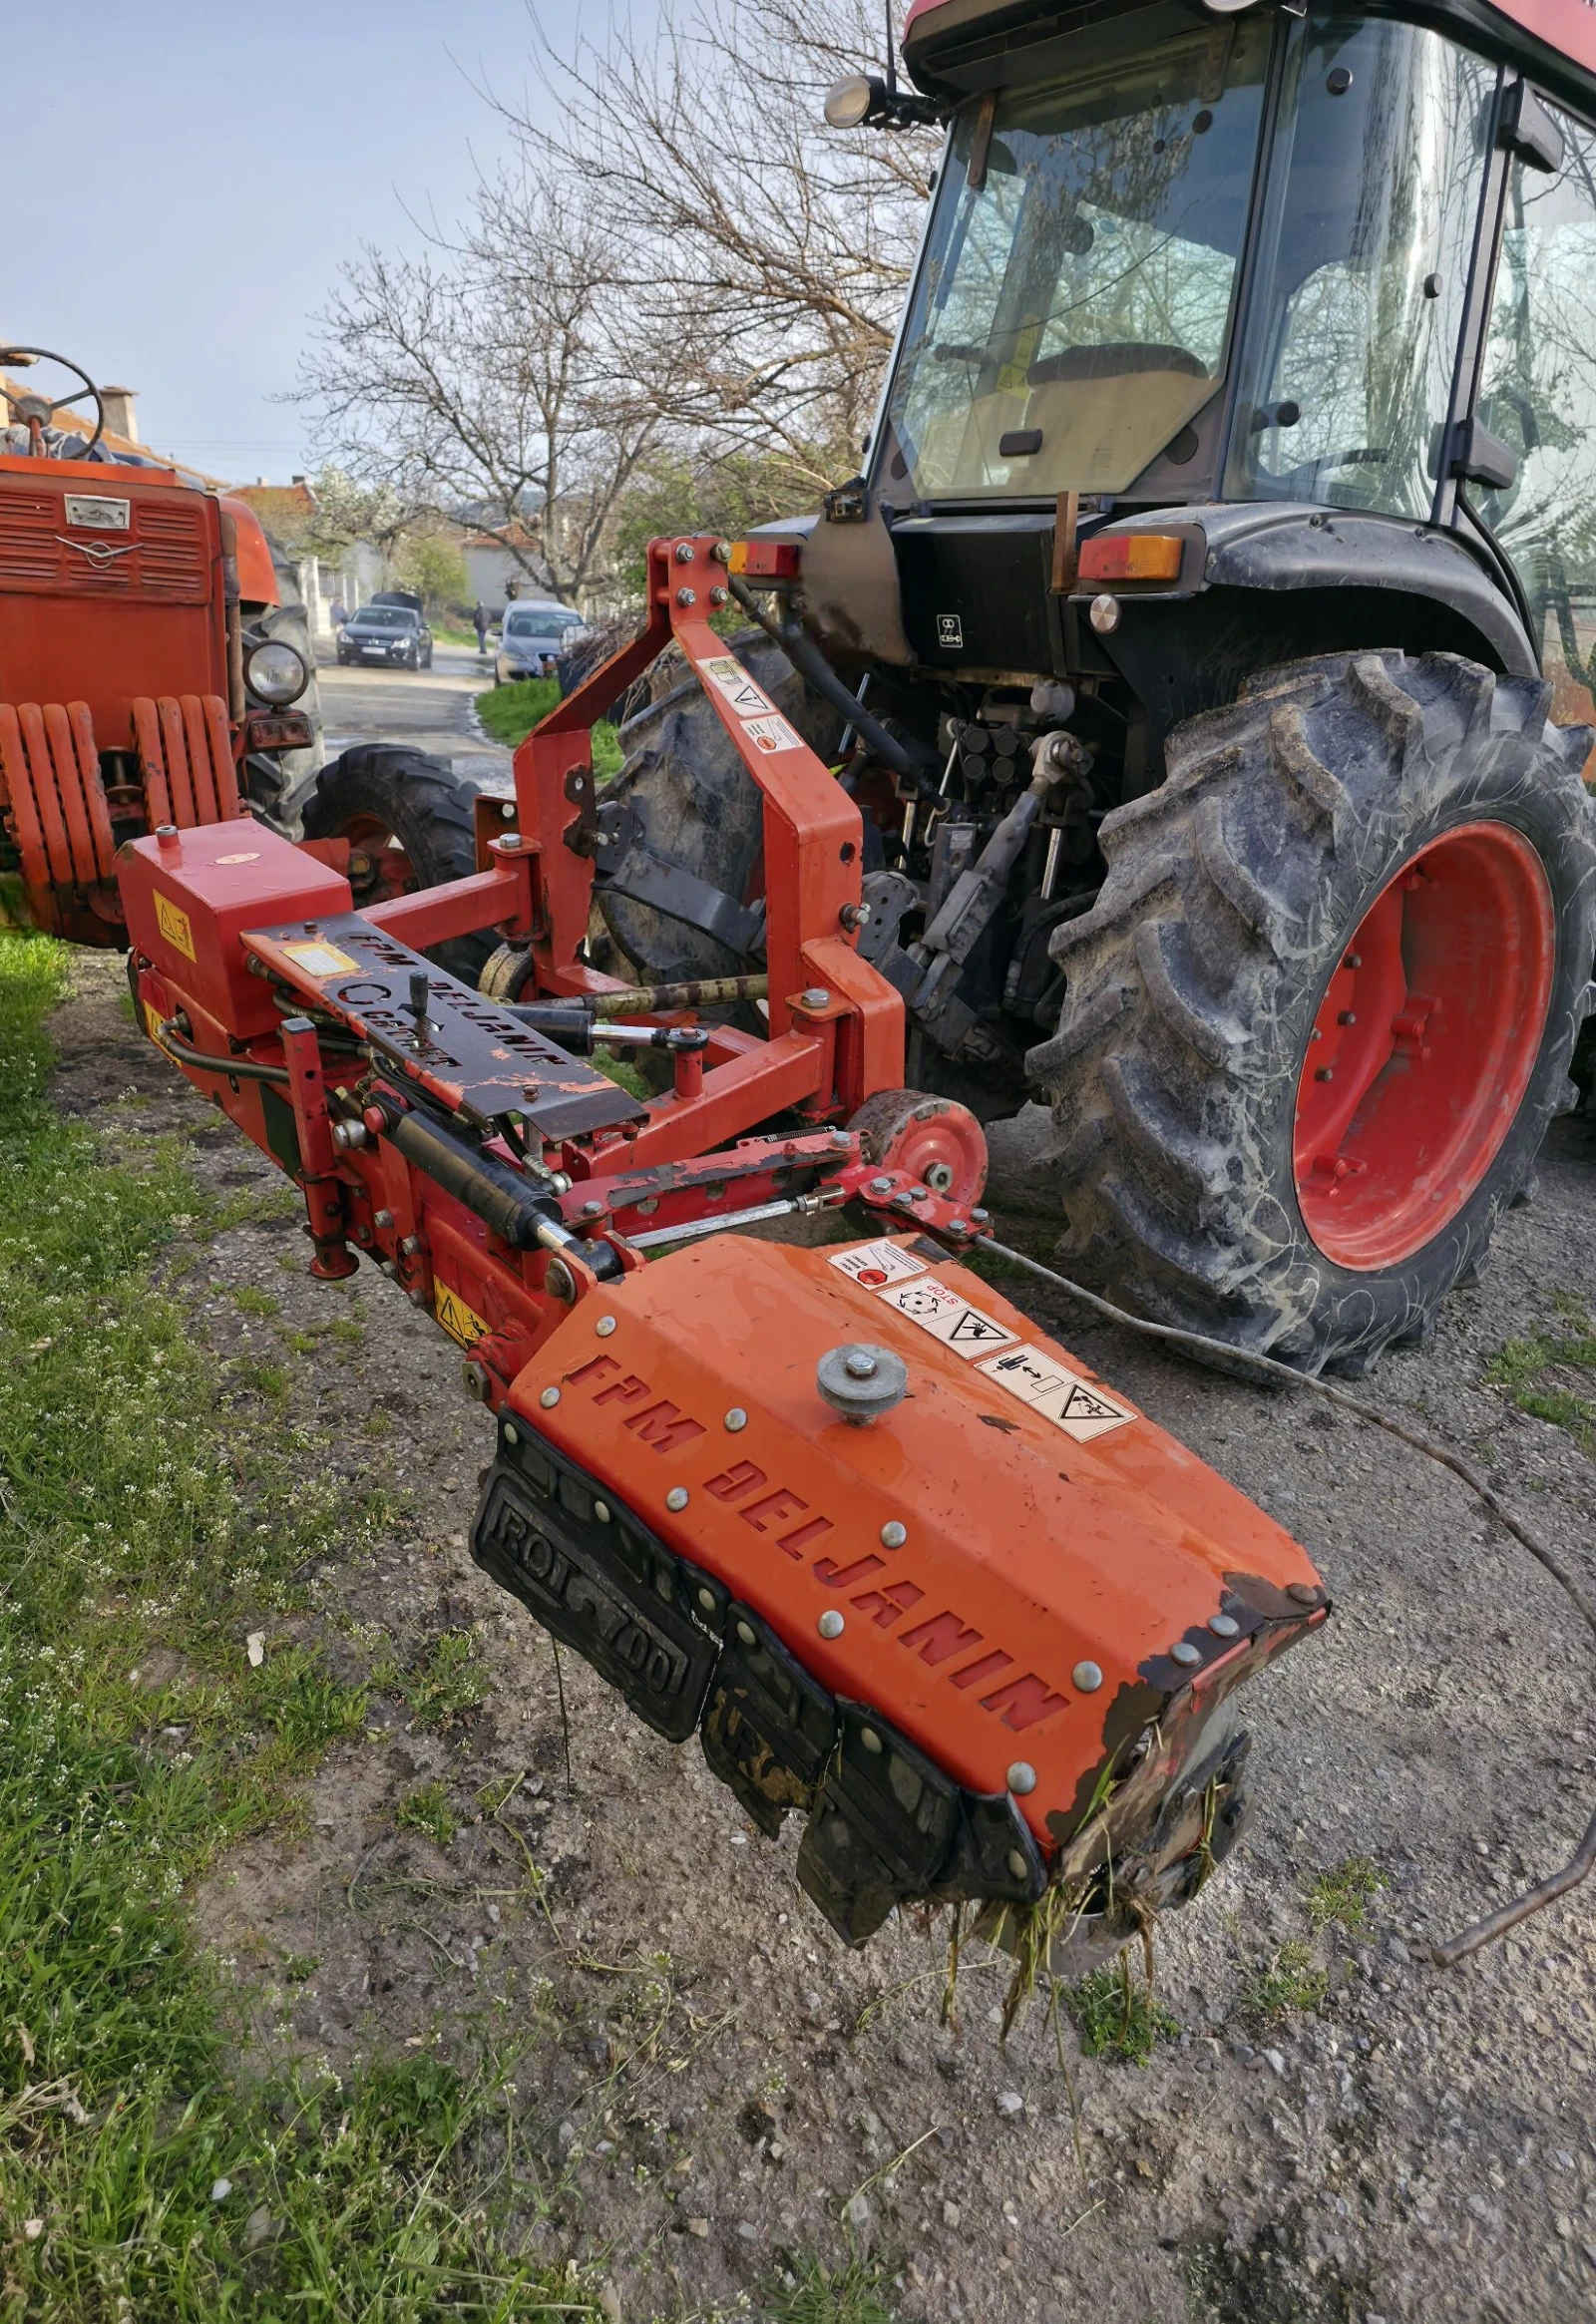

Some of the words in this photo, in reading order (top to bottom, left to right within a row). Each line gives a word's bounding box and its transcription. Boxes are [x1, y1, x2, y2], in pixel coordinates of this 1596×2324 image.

[349, 936, 420, 966] FPM
[428, 981, 569, 1065] DELJANIN
[927, 1285, 959, 1305] STOP
[566, 1355, 707, 1453] FPM
[703, 1459, 1070, 1733] DELJANIN
